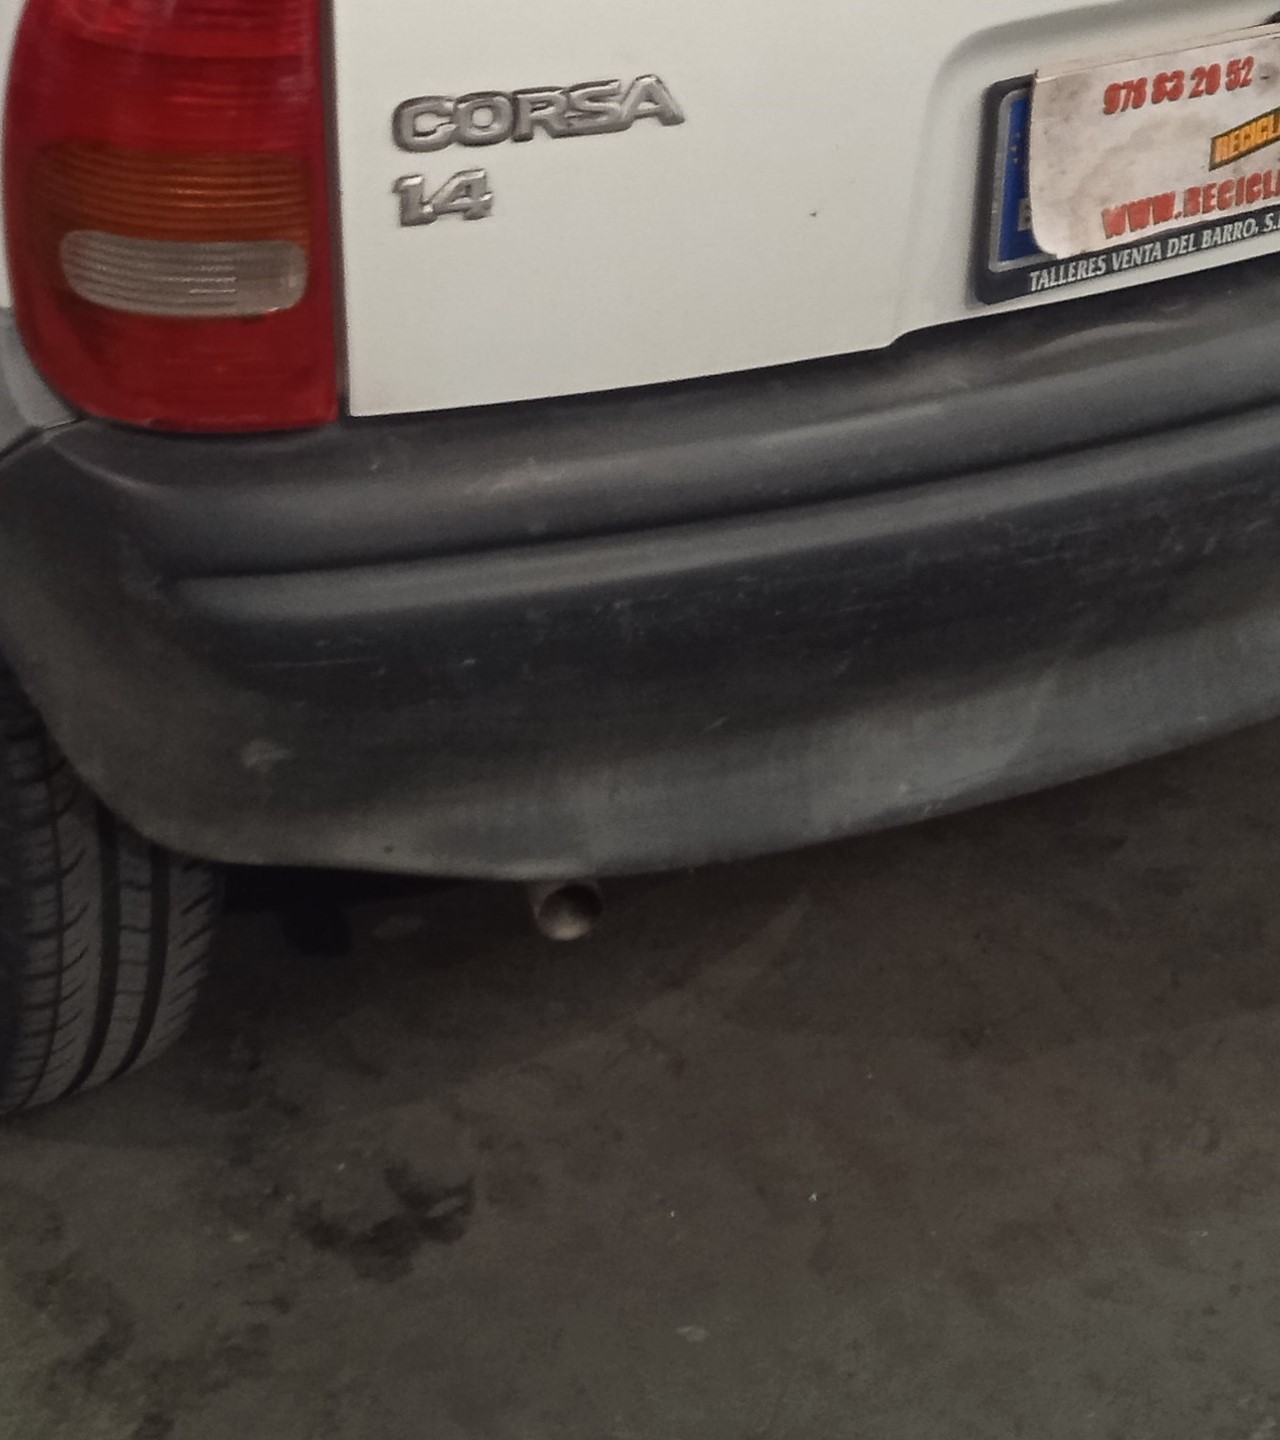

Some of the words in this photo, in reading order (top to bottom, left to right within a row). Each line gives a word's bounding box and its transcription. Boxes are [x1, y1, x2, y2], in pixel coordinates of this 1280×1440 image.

[1225, 55, 1255, 92] 52
[391, 73, 686, 153] CORSA
[1029, 253, 1106, 292] TALLERES
[1110, 243, 1163, 272] VENTA
[1166, 233, 1196, 259] DEL
